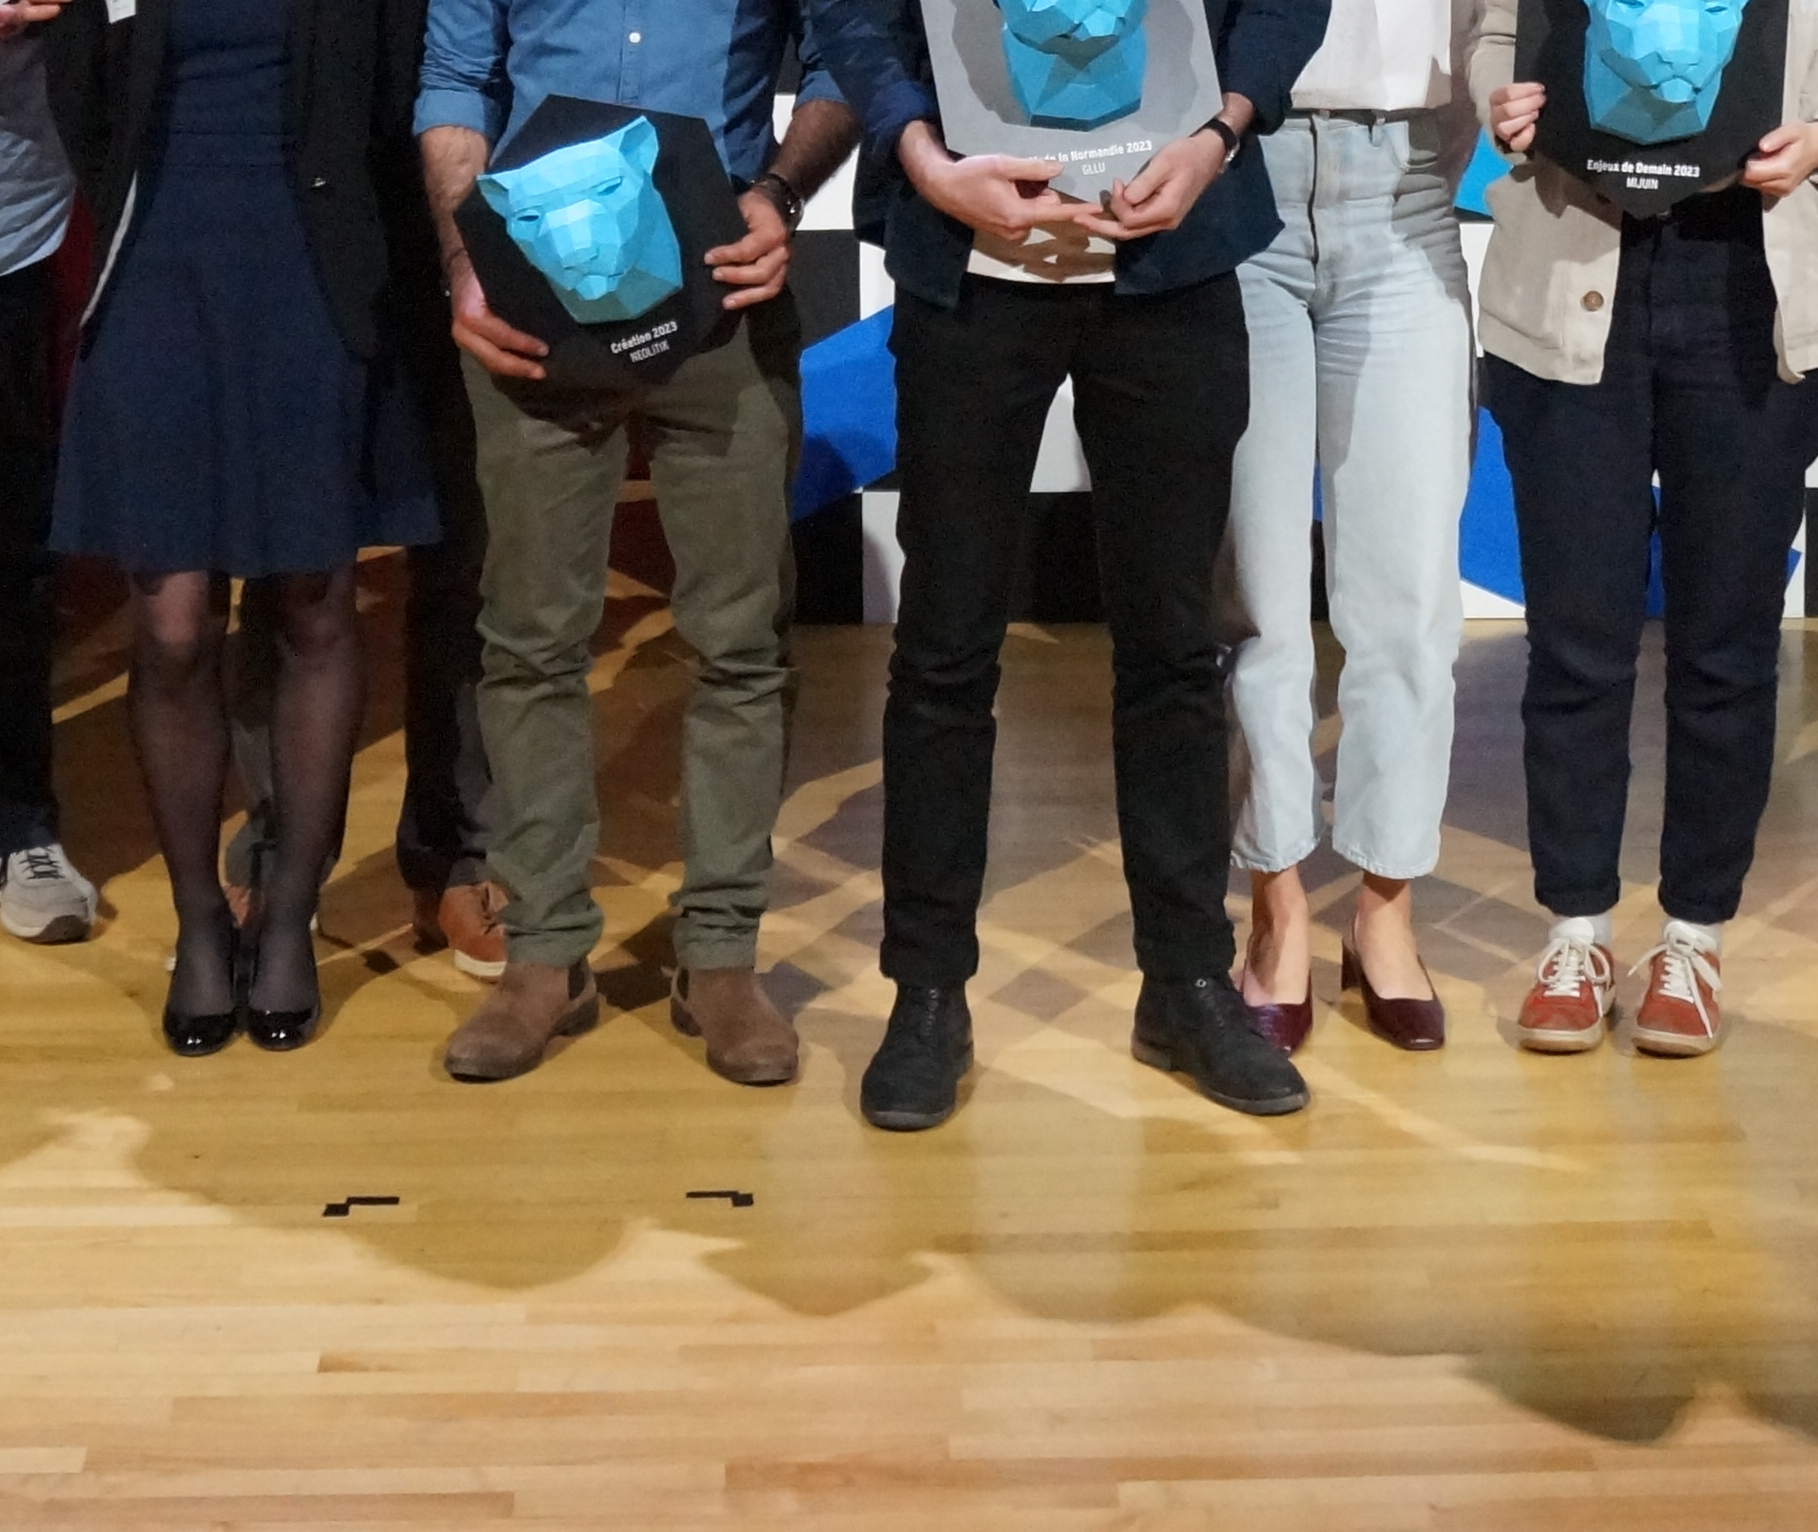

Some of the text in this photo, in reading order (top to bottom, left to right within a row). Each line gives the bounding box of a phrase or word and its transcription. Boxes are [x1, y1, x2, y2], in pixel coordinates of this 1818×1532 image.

[1070, 144, 1124, 162] Normandie
[1126, 139, 1153, 154] 2023
[1082, 162, 1106, 176] GLLU
[1586, 159, 1700, 178] Enjeux de Demain 2023
[610, 321, 679, 355] Création 2023
